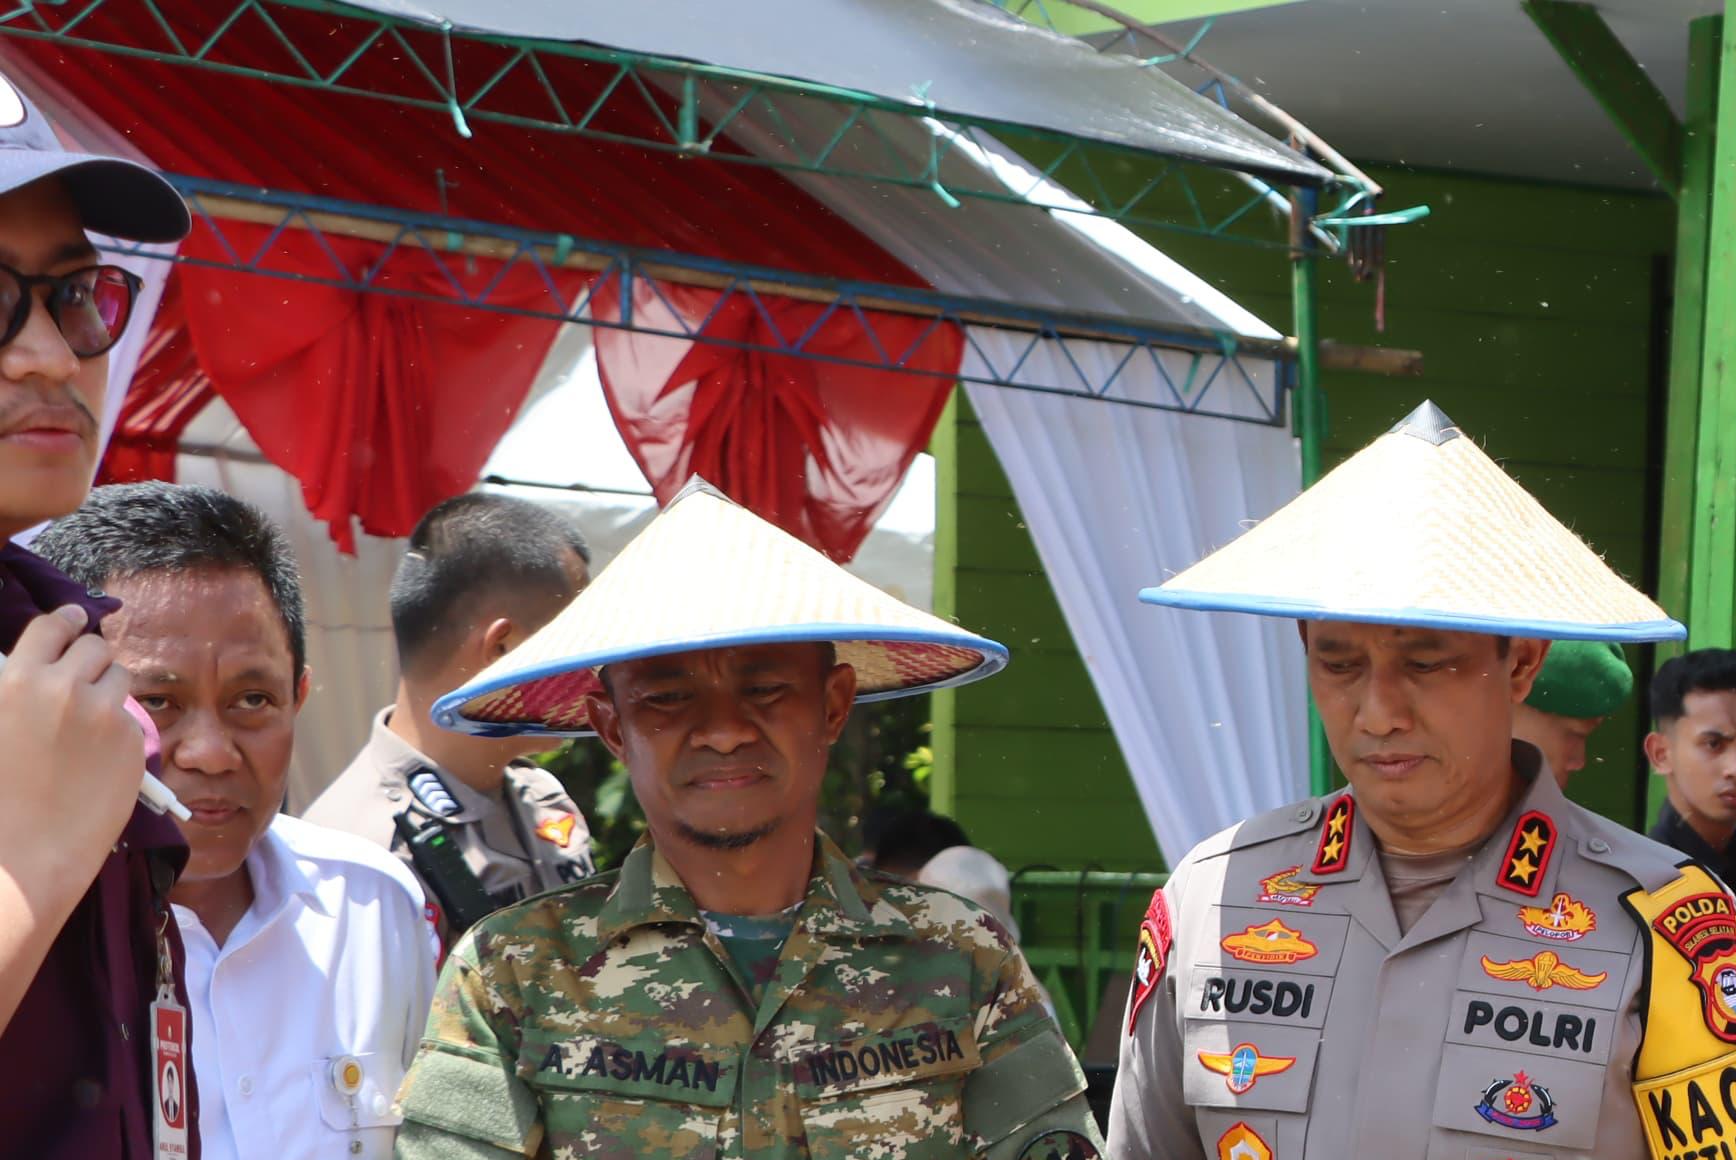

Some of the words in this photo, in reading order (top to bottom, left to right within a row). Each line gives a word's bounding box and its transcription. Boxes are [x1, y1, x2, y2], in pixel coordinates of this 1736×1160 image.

[1663, 898, 1730, 934] POLDA
[1200, 978, 1315, 1019] RUSDI
[1463, 1000, 1596, 1053] POLRI
[808, 1029, 964, 1086] INDONESIA
